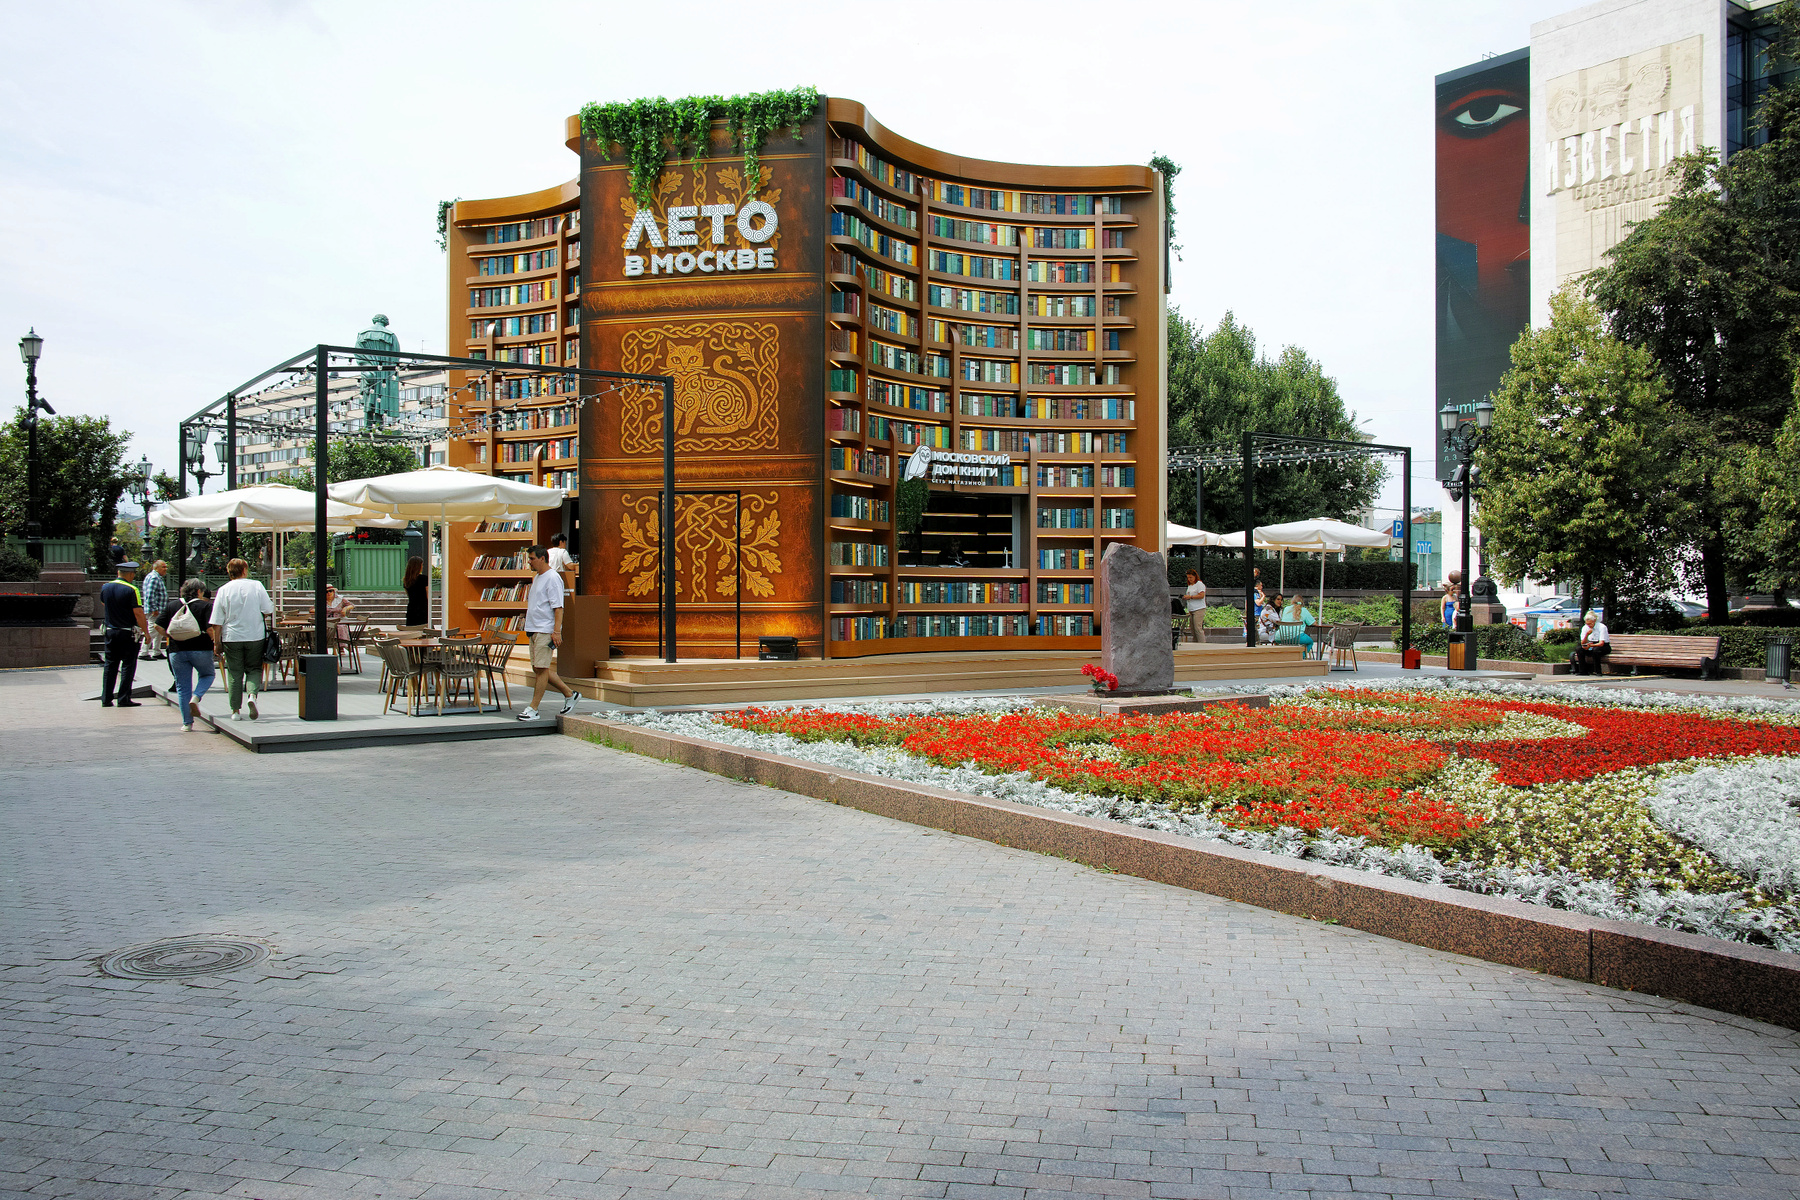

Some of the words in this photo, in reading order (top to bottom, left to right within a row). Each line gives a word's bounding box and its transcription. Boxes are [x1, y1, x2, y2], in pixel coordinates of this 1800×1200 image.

[1546, 105, 1695, 194] ИЗВЕСТИЯ
[624, 200, 779, 250] ЛЕТО
[625, 255, 644, 277] В
[651, 247, 775, 275] МОСКВЕ
[932, 451, 1010, 465] МОСКОВСКИЙ
[932, 464, 958, 476] ДОМ
[959, 466, 998, 477] КНИГИ
